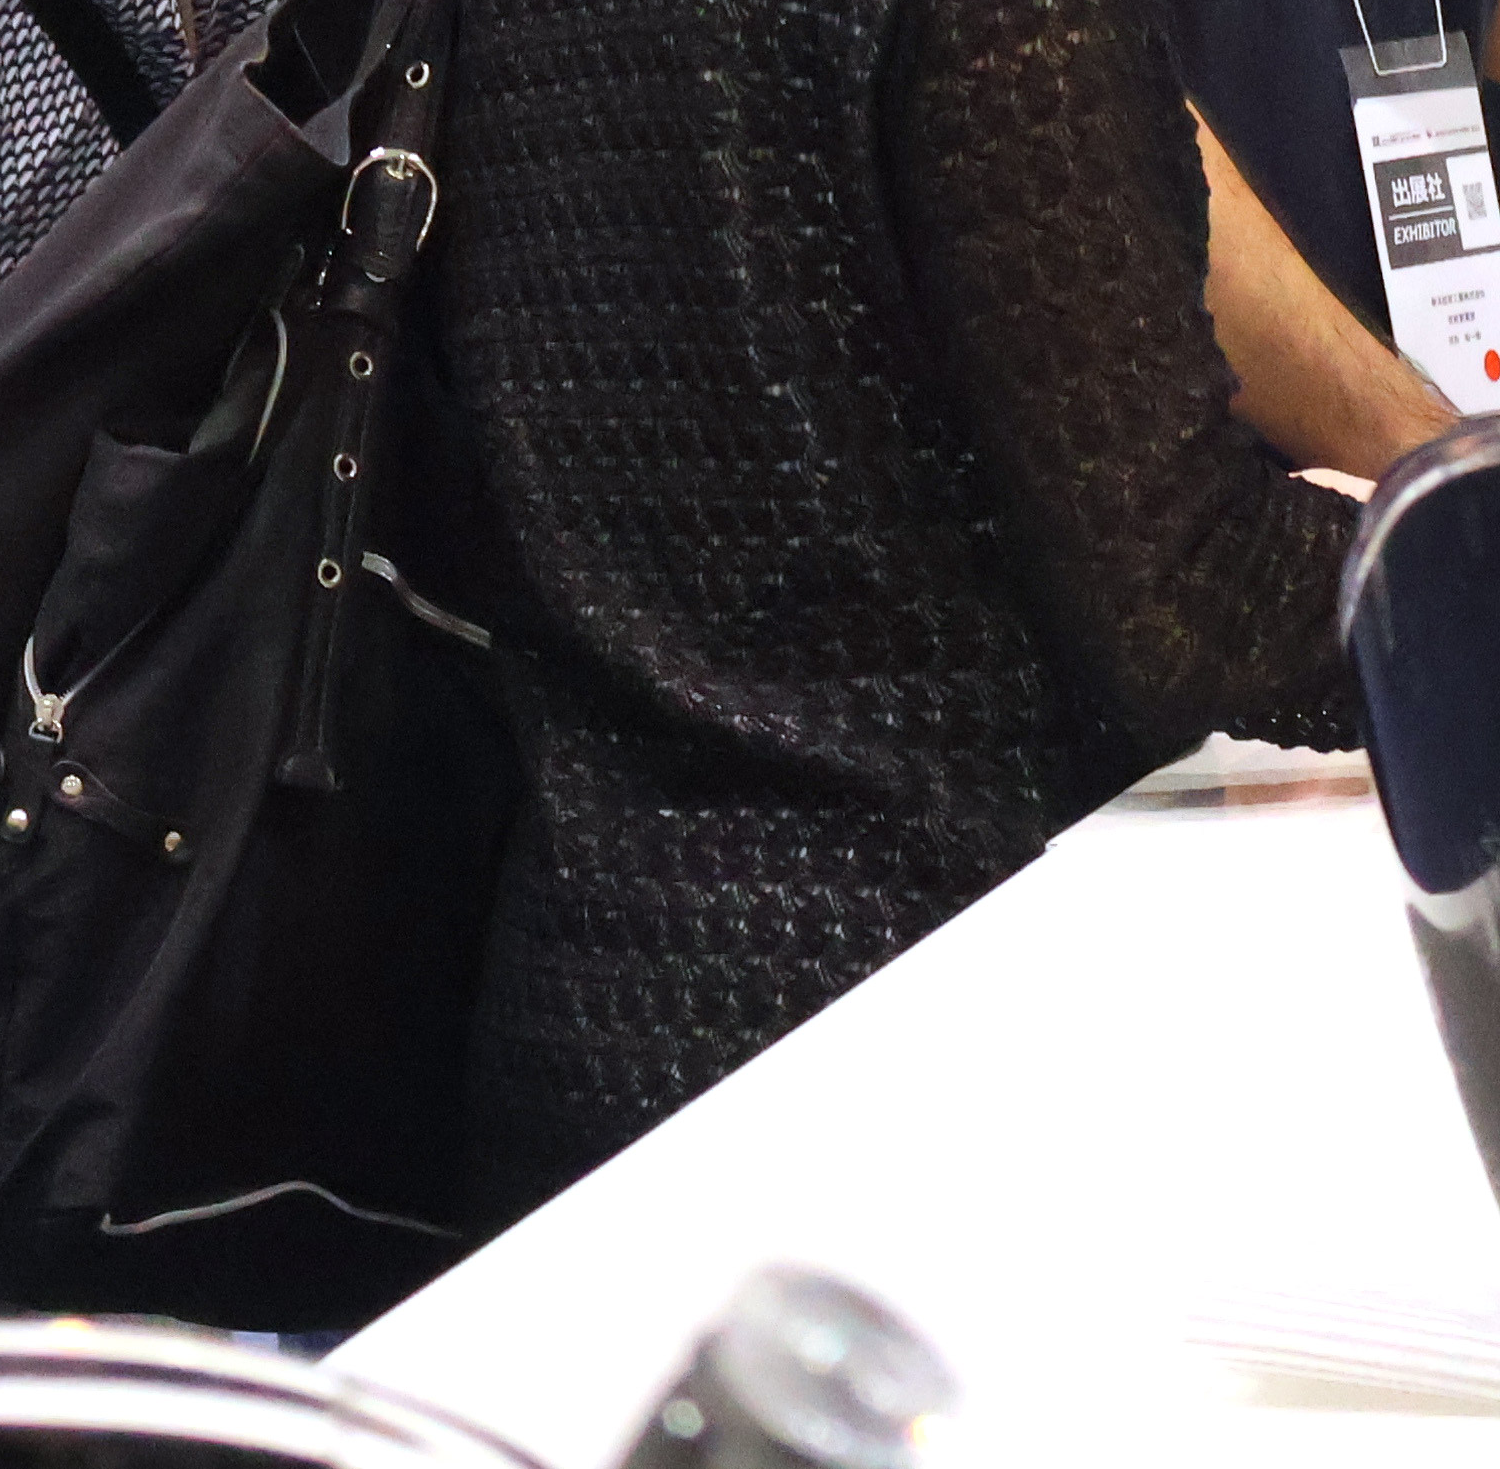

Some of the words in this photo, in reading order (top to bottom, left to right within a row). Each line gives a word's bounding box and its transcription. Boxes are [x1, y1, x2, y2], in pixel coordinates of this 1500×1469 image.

[1391, 172, 1446, 207] 出展社
[1393, 217, 1457, 246] EXHIBITOR
